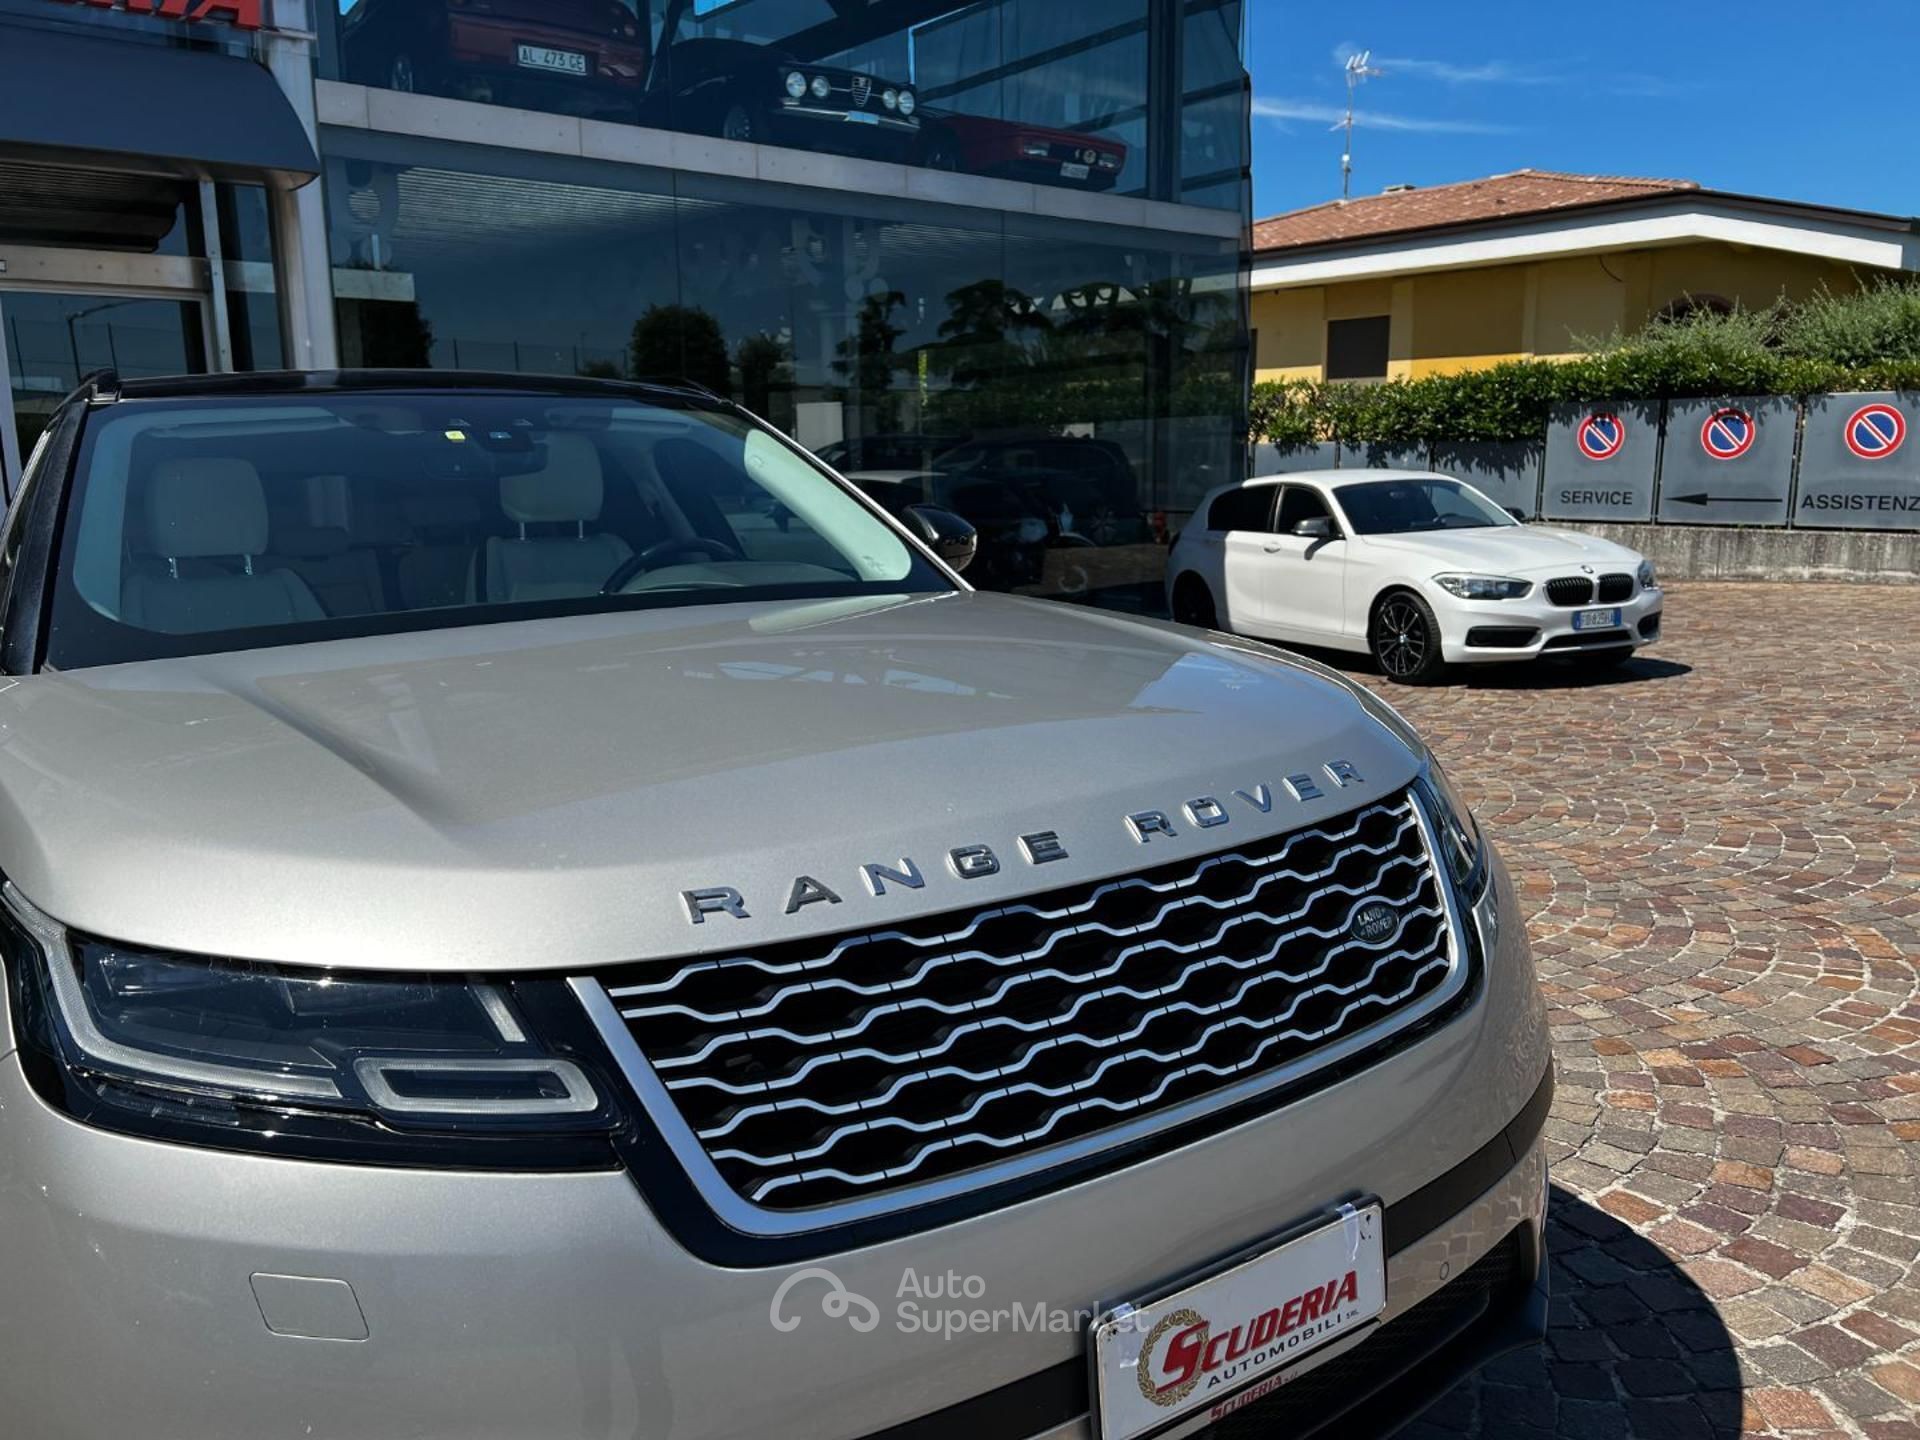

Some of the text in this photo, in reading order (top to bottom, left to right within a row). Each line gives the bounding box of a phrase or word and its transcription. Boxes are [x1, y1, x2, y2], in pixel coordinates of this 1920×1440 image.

[1560, 489, 1633, 506] SERVICE
[681, 759, 1365, 924] RANGE ROVER
[1357, 907, 1382, 926] LAND
[1156, 1270, 1357, 1394] SCUDERIA
[1207, 1314, 1342, 1389] AUTOMOBILI
